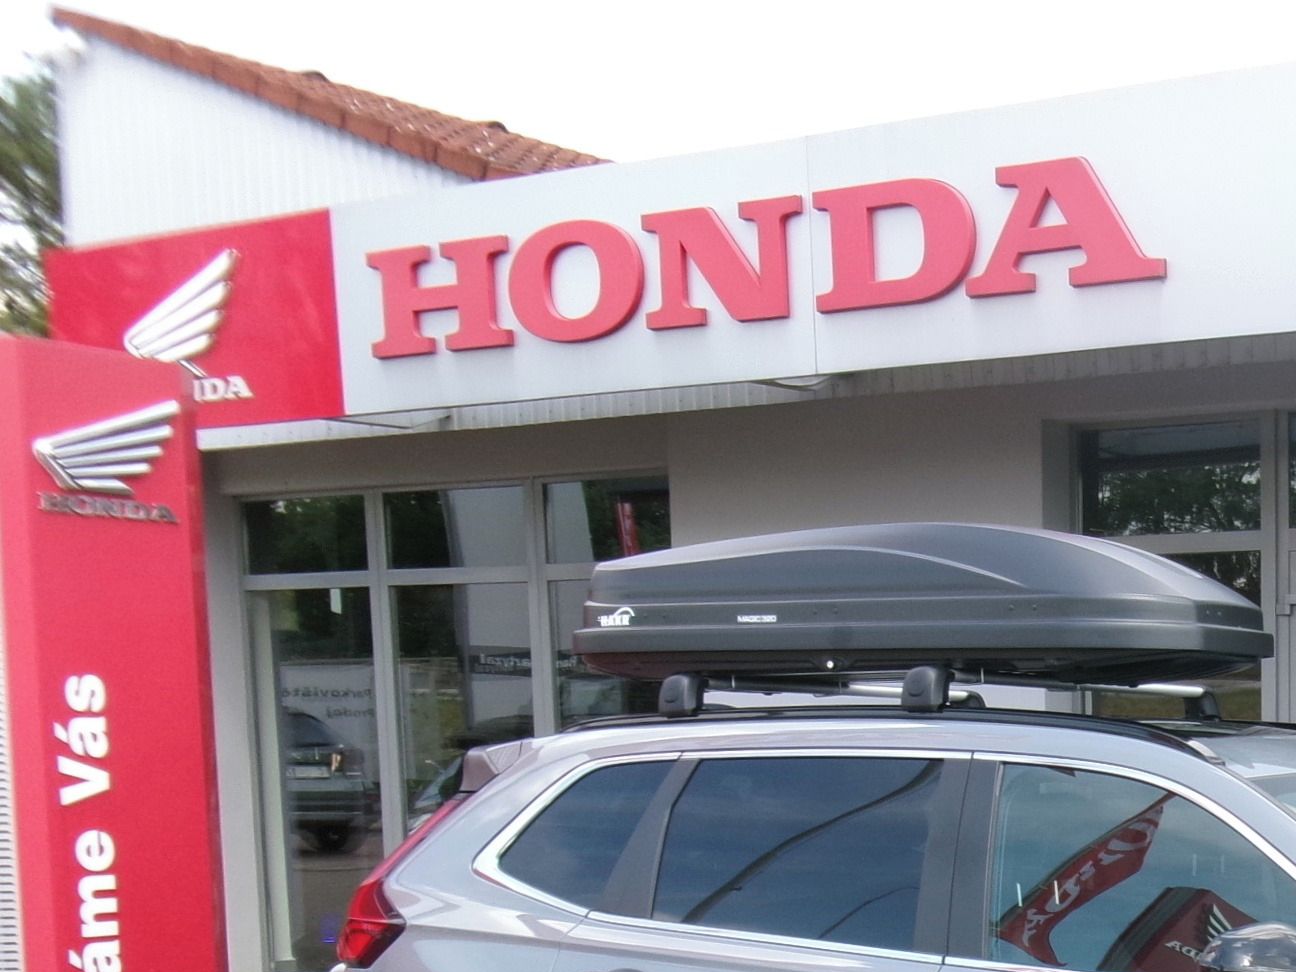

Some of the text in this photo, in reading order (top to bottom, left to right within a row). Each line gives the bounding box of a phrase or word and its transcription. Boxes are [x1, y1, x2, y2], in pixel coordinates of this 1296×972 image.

[365, 156, 1168, 361] HONDA
[36, 491, 180, 525] HONDA
[53, 673, 112, 807] Vás
